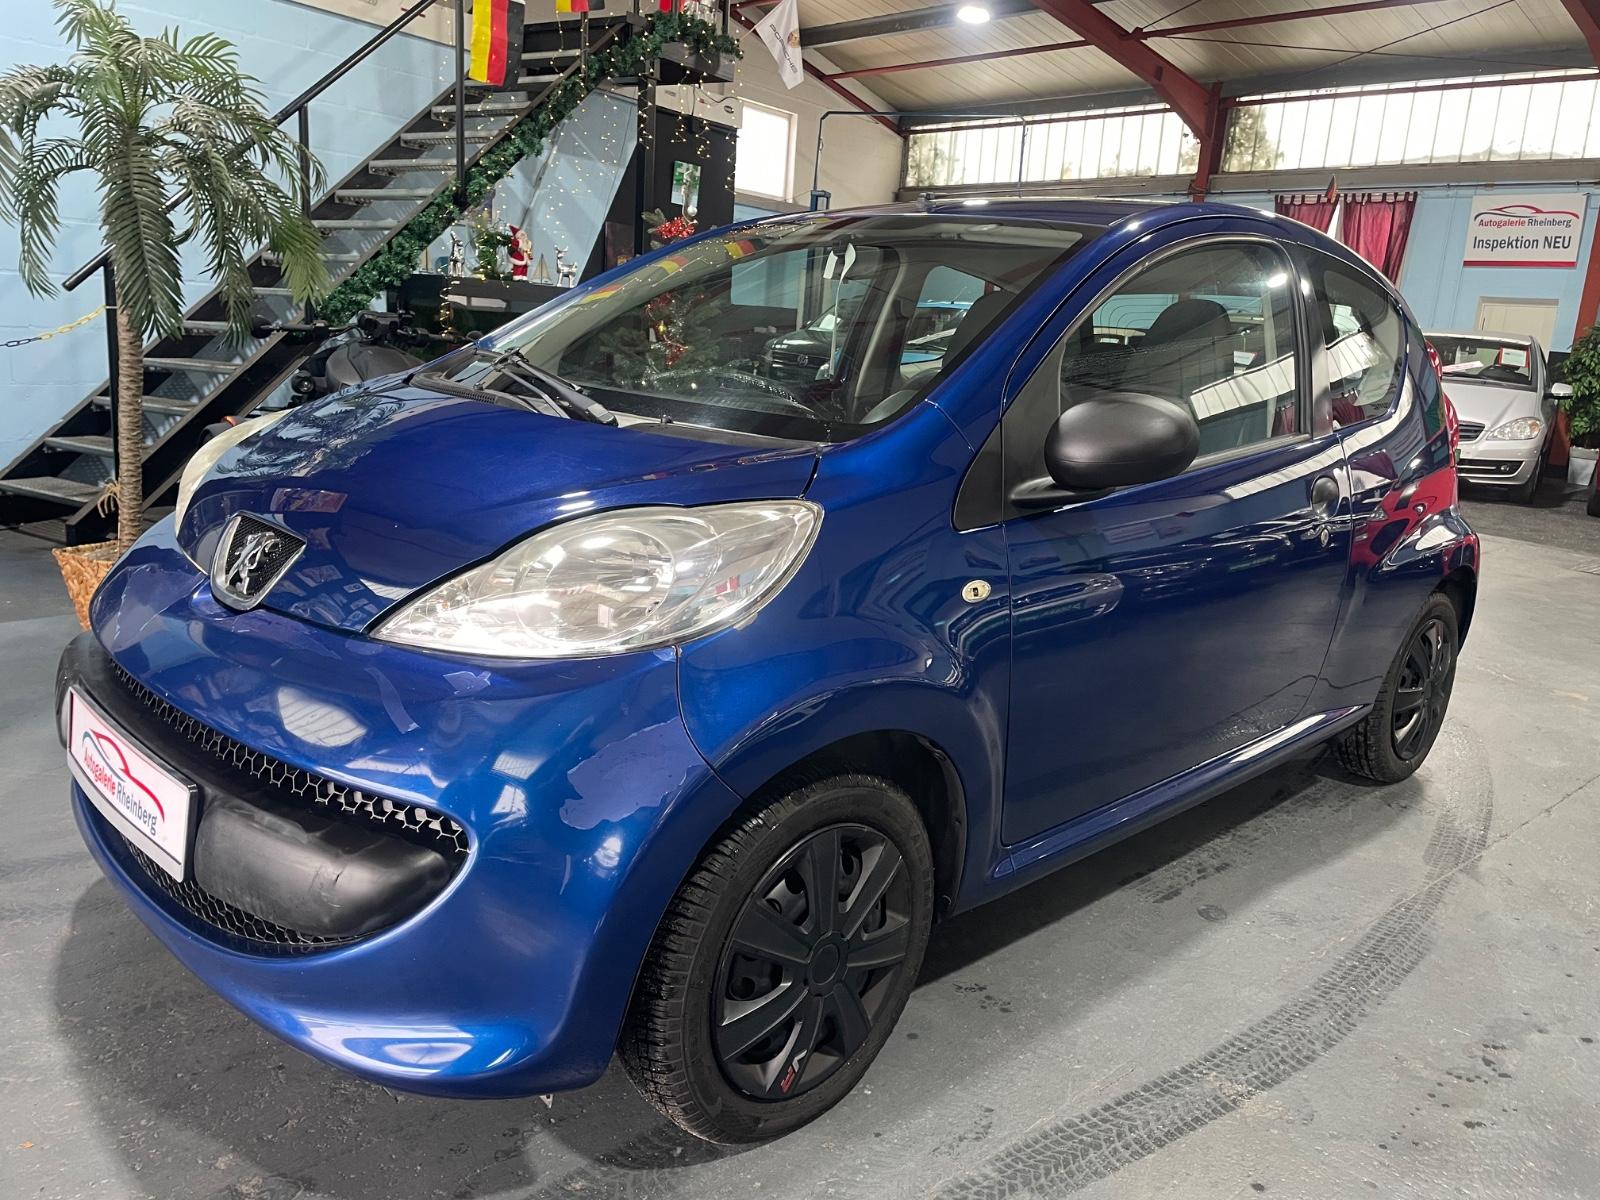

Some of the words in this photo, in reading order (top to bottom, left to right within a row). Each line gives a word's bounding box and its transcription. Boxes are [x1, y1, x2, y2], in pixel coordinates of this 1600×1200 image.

[770, 24, 798, 73] PORSCHE
[1478, 218, 1526, 229] Autogalerie
[1527, 218, 1572, 228] Rheinberg
[1473, 235, 1539, 252] Inspektion
[1543, 235, 1572, 249] NEU
[83, 747, 116, 795] Autogalerie
[116, 784, 158, 836] Rheinberg
